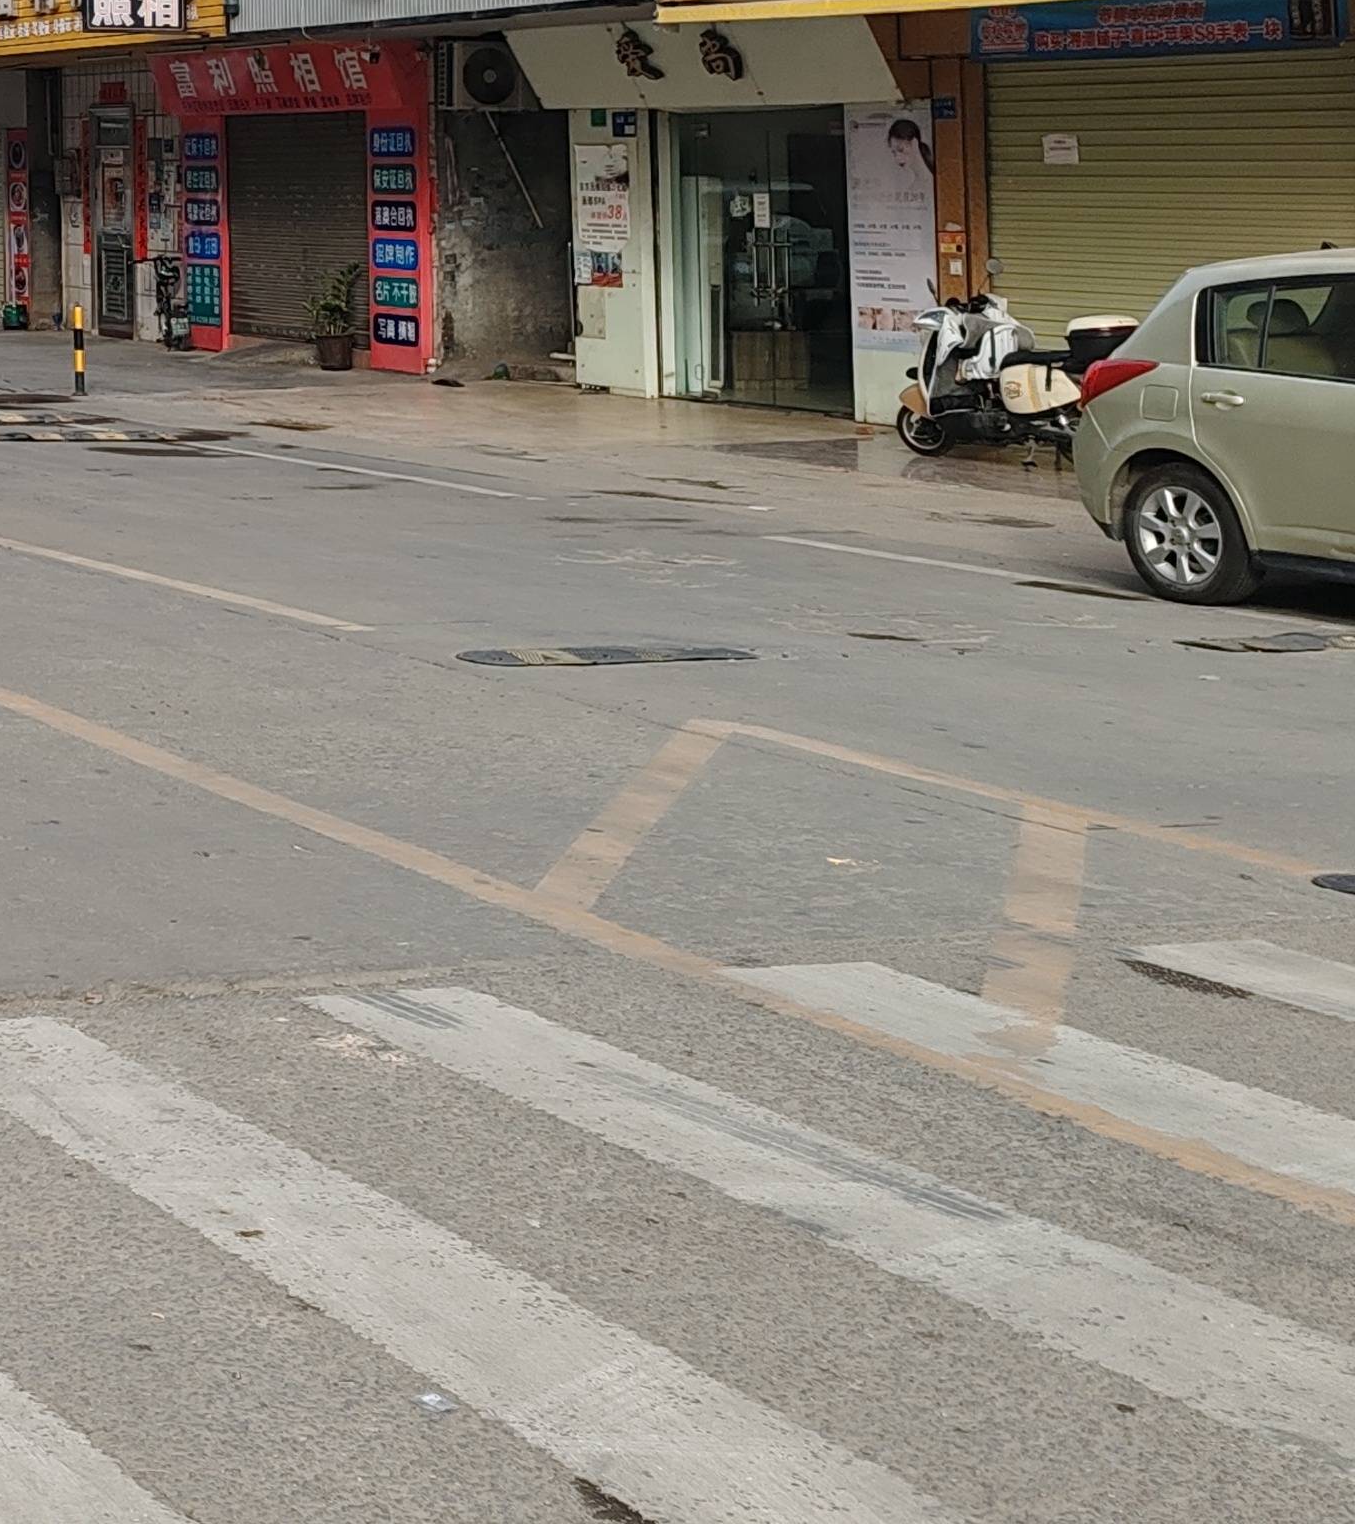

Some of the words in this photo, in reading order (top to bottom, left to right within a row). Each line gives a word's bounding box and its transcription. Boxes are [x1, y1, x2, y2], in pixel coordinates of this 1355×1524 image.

[170, 47, 369, 99] 富利照相馆
[372, 132, 413, 152] 身份证回执
[373, 169, 414, 190] 保安证回执
[375, 244, 415, 265] 招牌制作
[374, 281, 390, 302] 名片
